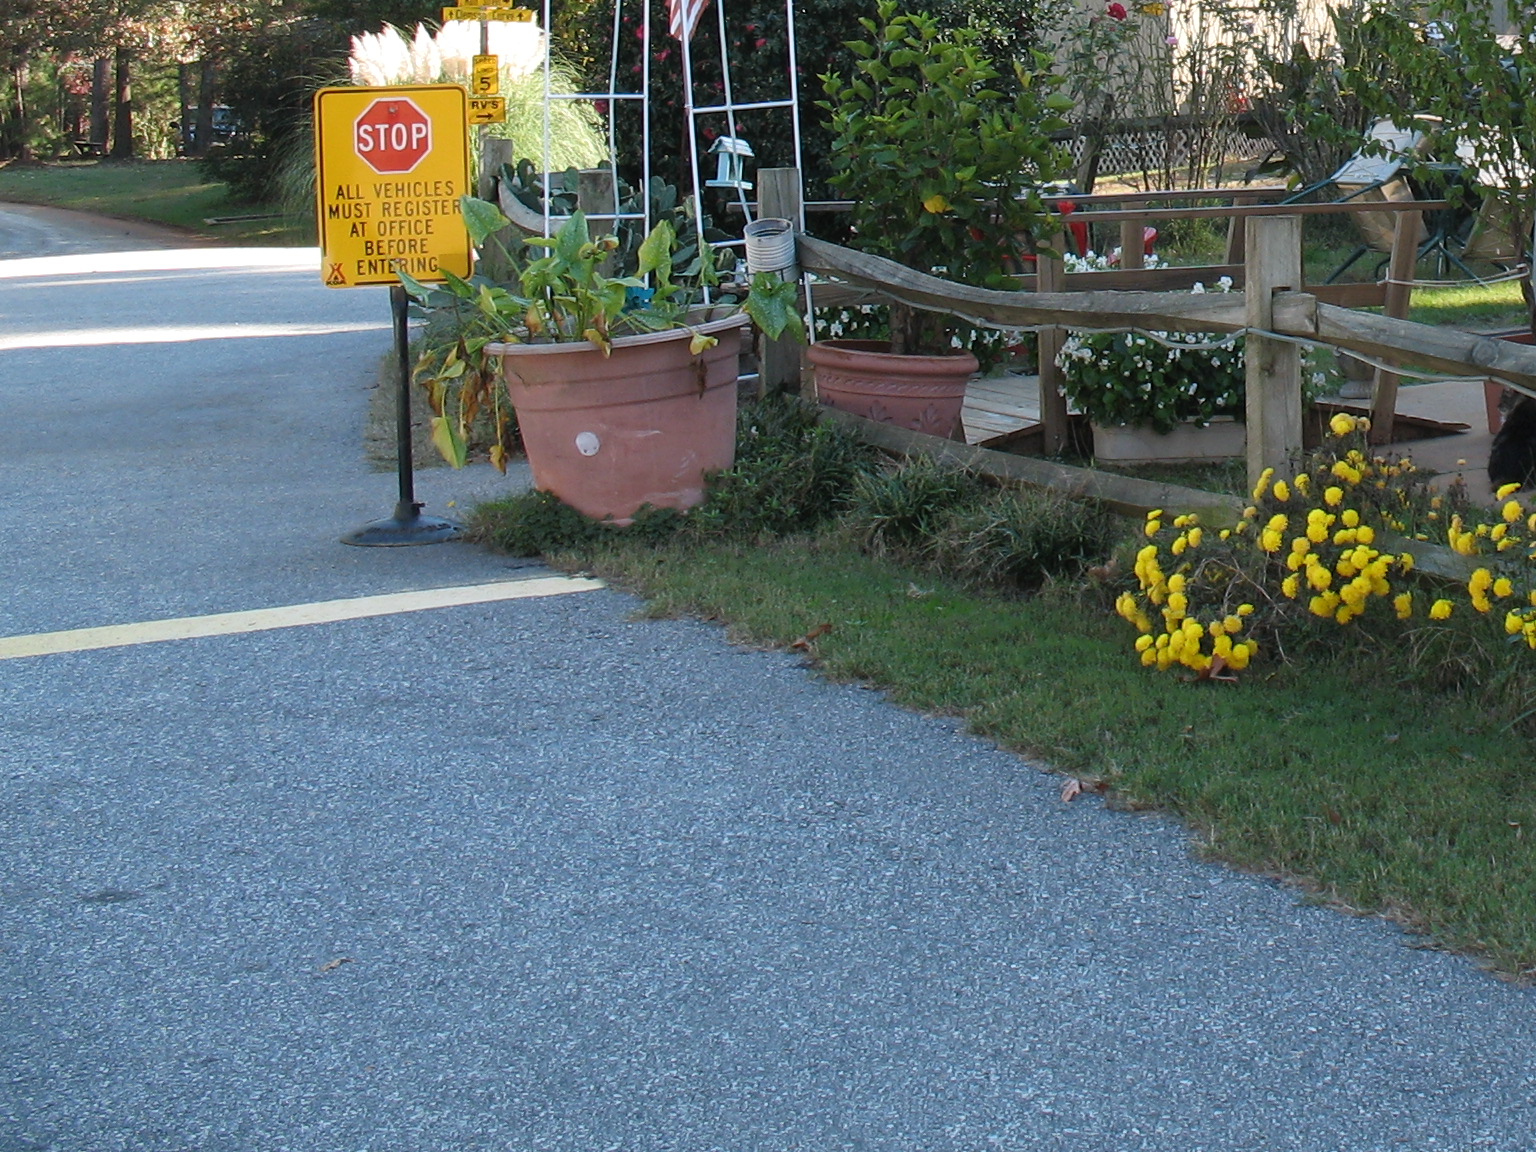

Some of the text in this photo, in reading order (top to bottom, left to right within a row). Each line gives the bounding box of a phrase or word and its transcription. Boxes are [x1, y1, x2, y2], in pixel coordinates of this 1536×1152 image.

[480, 76, 491, 90] 5
[358, 122, 428, 152] STOP
[336, 180, 454, 200] ALL VEHICLES
[328, 199, 462, 220] MUST REGISTER
[349, 218, 434, 238] AT OFFICE
[364, 238, 429, 256] BEFORE
[356, 256, 438, 276] ENTERING
